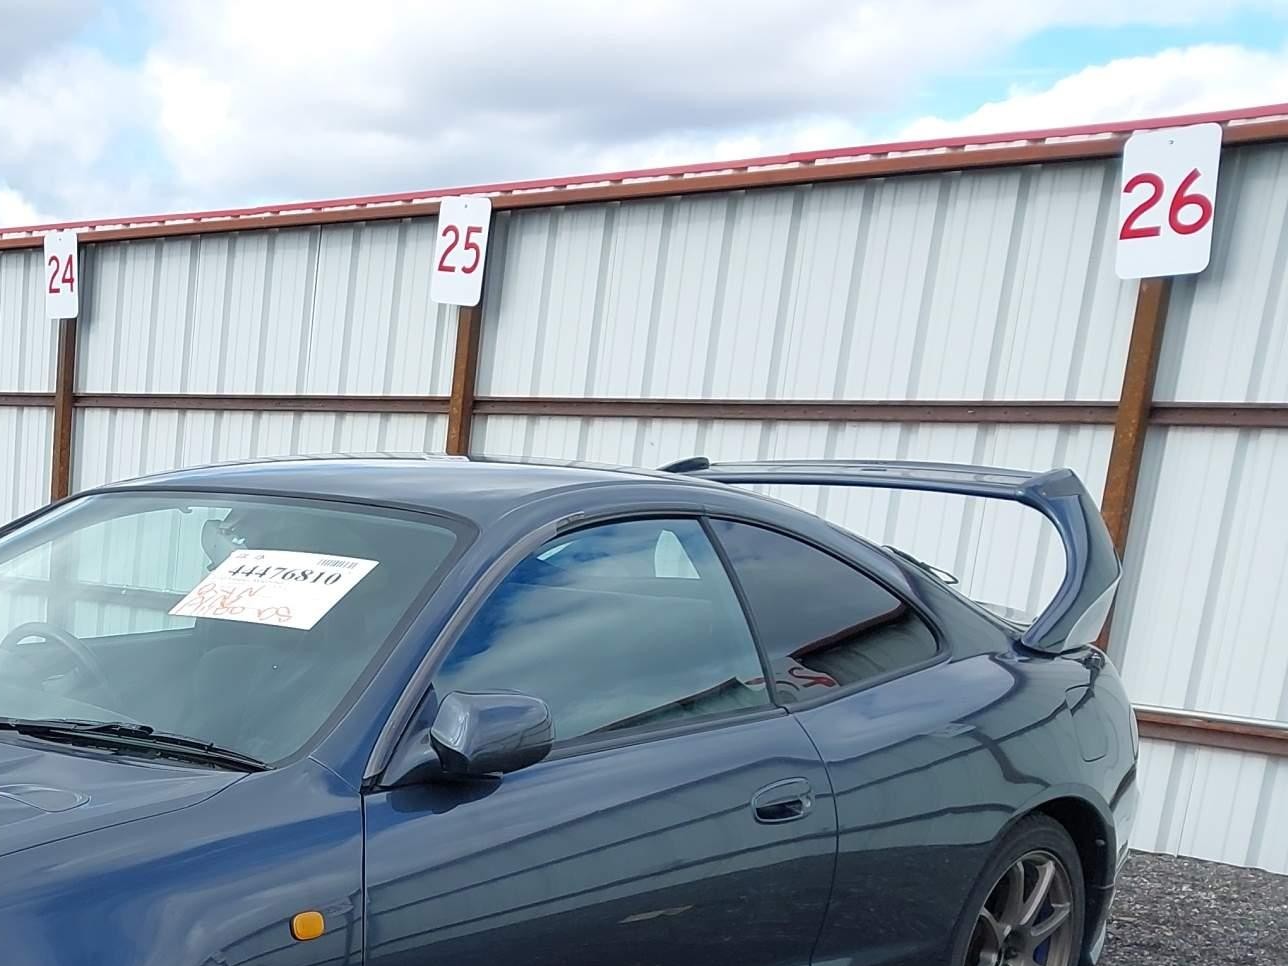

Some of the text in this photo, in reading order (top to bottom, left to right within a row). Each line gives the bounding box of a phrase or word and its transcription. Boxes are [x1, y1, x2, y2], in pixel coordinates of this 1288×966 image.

[1119, 167, 1213, 241] 26
[437, 224, 483, 274] 25
[47, 254, 75, 294] 24
[228, 564, 342, 586] 44476810
